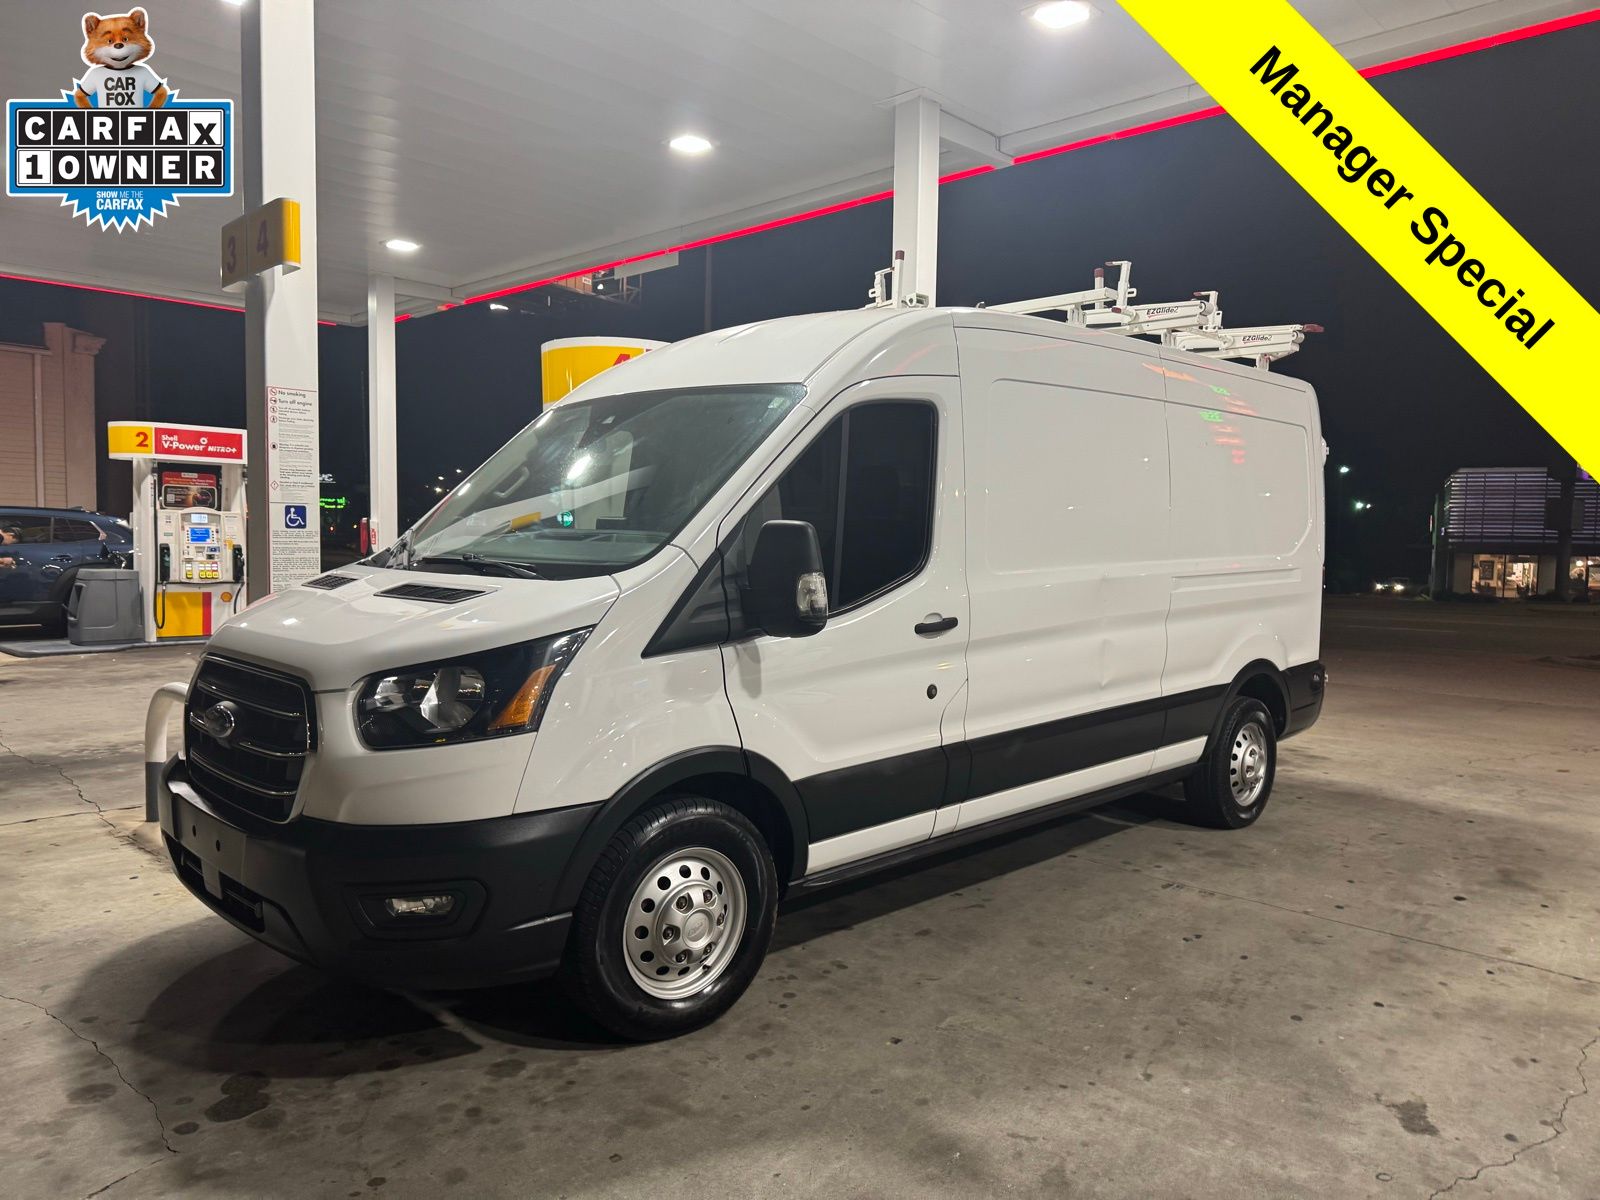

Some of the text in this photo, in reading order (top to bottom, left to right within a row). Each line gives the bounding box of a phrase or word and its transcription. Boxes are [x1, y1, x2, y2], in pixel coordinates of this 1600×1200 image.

[226, 219, 269, 273] 3 4
[1146, 306, 1179, 315] EZGlide2
[136, 432, 149, 448] 2
[161, 434, 178, 442] Shell
[162, 440, 237, 454] V-Power NITRO+
